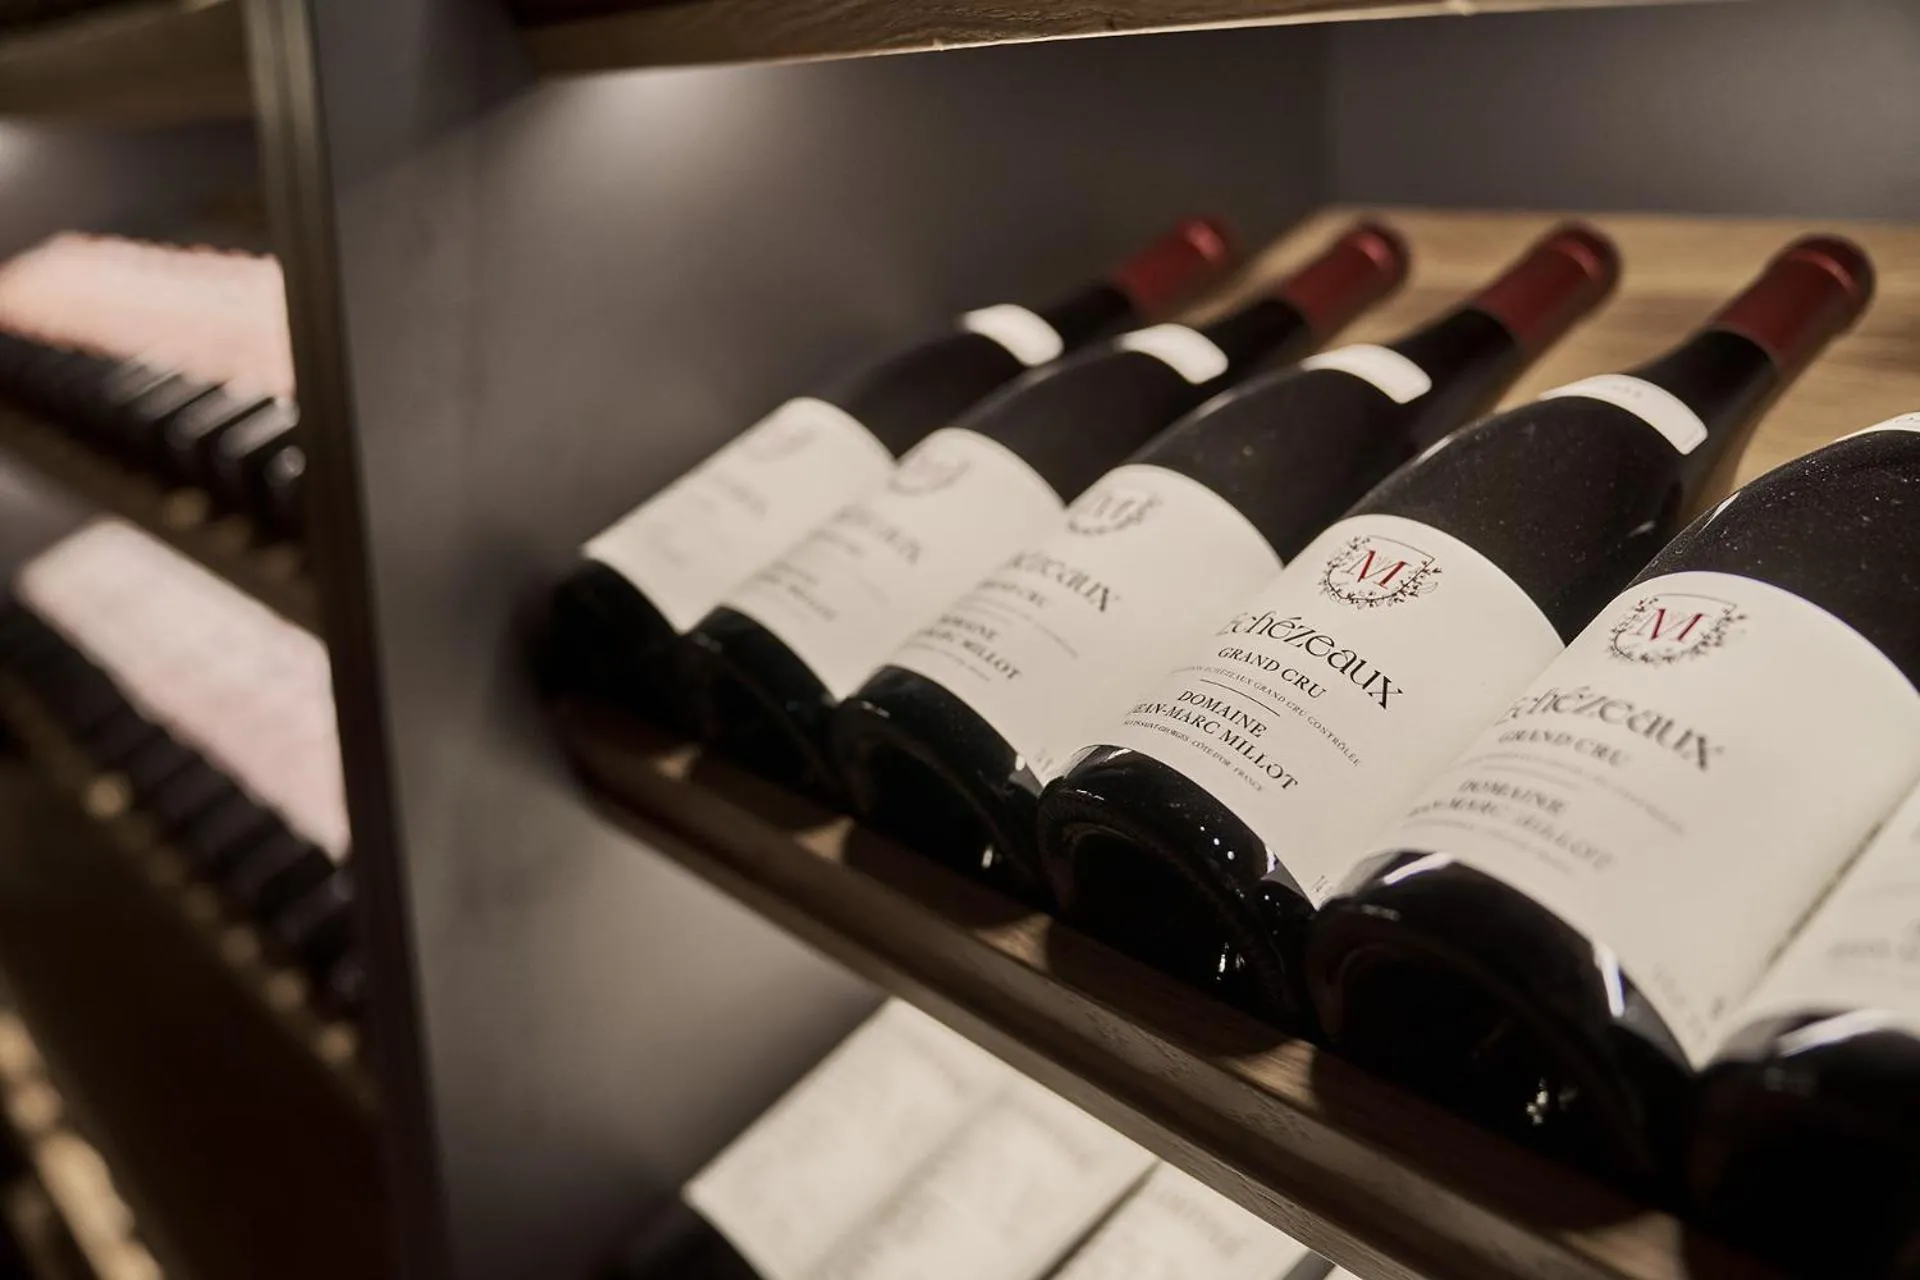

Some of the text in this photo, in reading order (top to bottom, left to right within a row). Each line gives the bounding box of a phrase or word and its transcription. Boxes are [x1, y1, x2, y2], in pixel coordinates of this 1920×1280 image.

[1339, 549, 1414, 590] M
[1628, 607, 1713, 644] M
[1217, 646, 1281, 672] GRAND
[1280, 667, 1328, 699] CRU
[1177, 689, 1268, 739] DOMAINE
[1218, 728, 1299, 790] MILLOT
